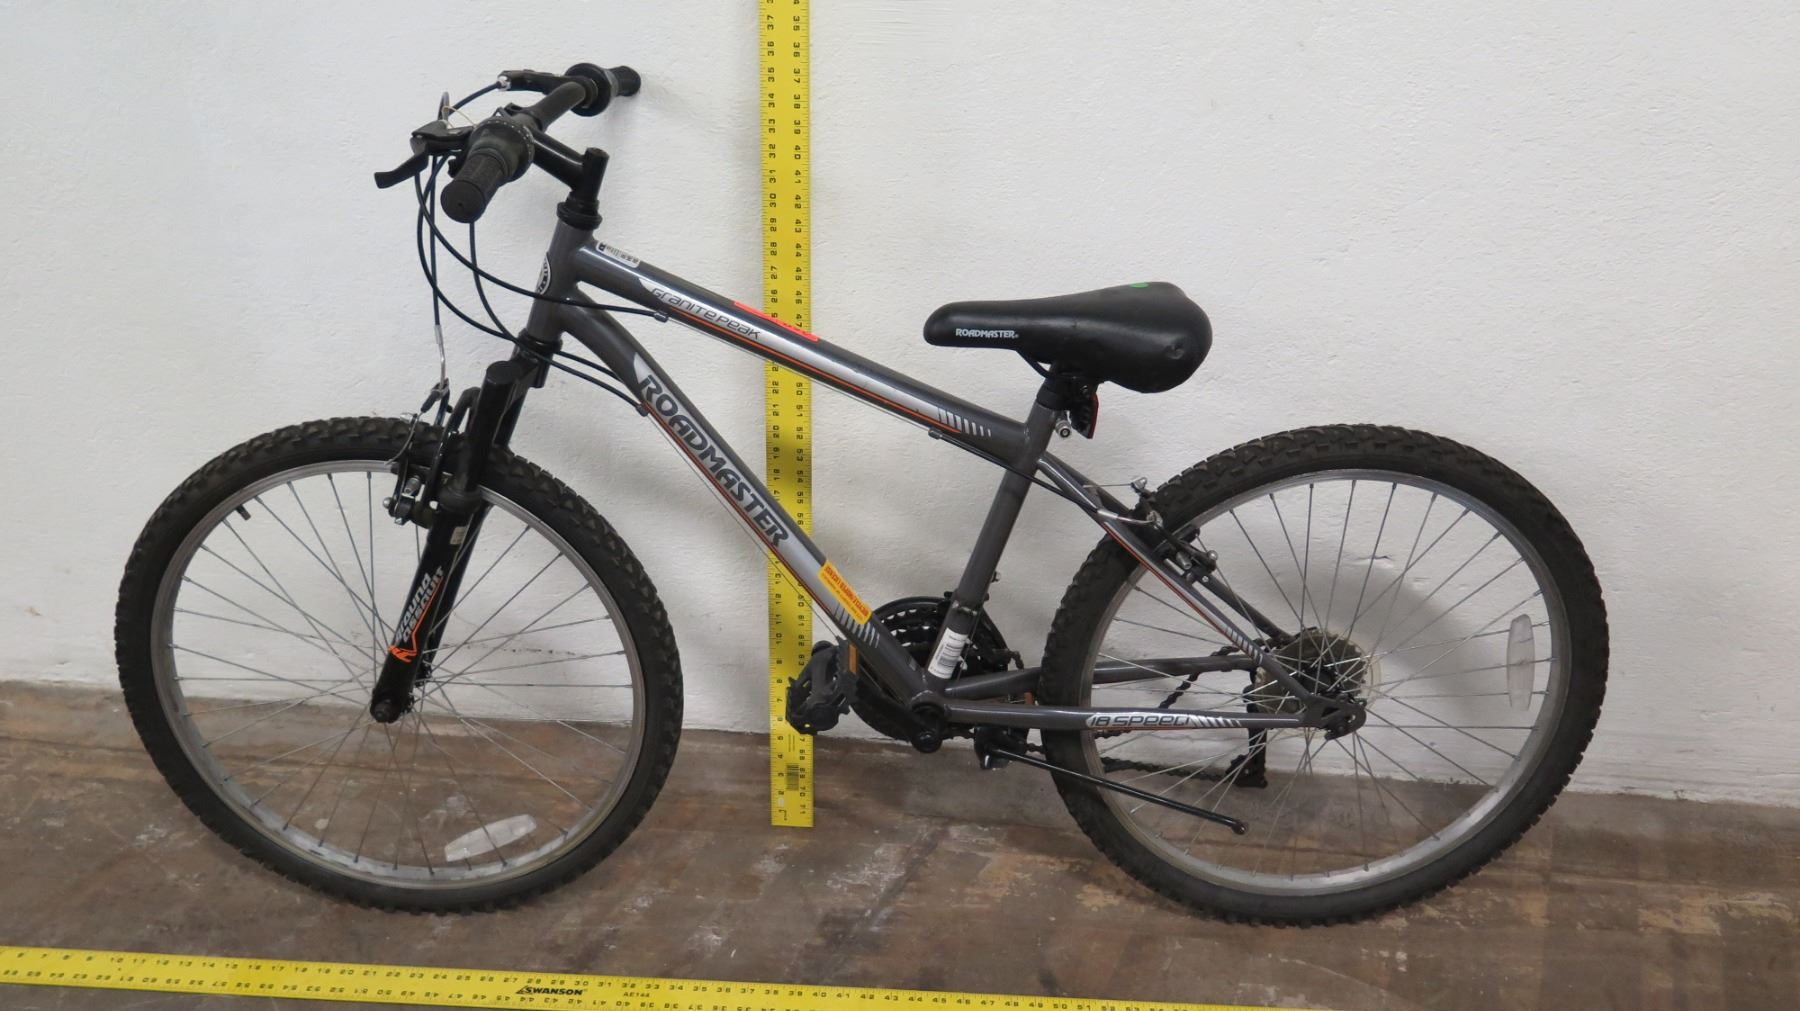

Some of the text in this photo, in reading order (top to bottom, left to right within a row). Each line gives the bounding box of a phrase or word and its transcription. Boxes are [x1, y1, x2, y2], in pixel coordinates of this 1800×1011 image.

[640, 375, 788, 547] ROADMASTER
[1090, 716, 1110, 726] 18
[526, 986, 584, 996] SWANSON
